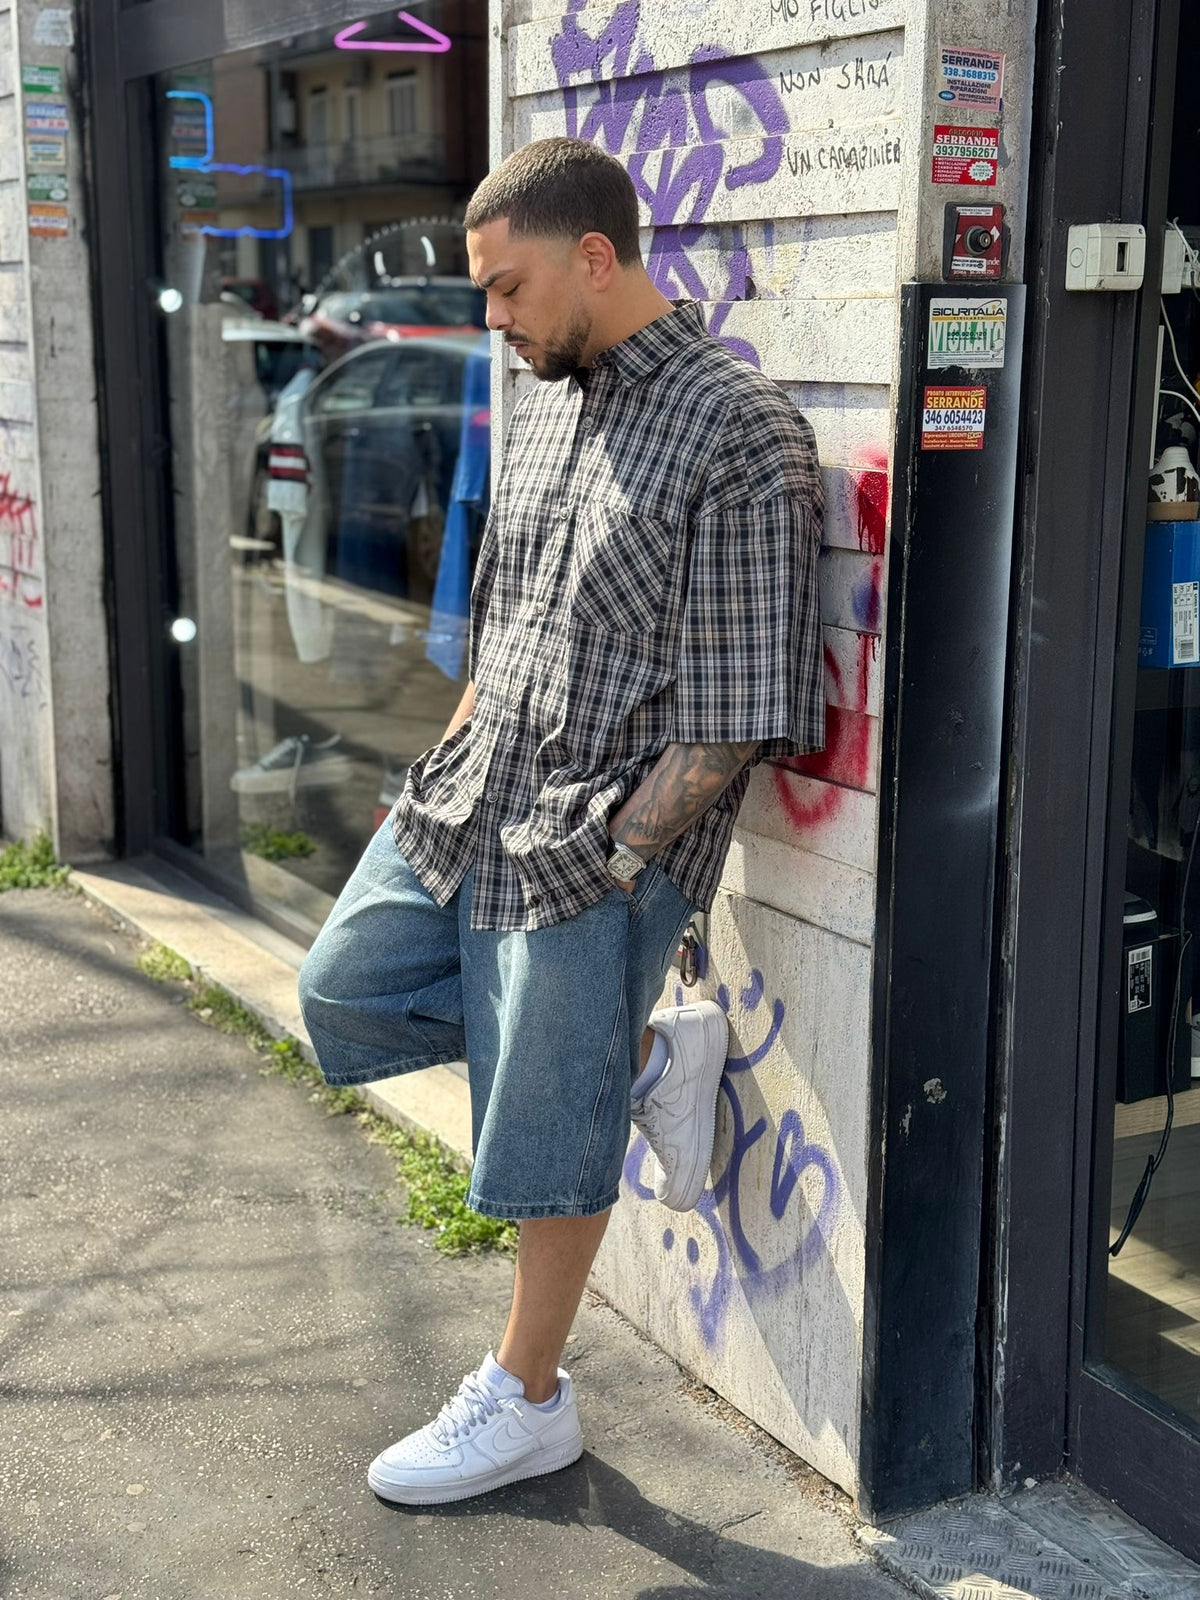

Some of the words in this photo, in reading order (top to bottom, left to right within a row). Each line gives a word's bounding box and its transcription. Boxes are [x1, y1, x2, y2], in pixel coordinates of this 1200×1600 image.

[941, 55, 1000, 70] SERRANDE
[780, 67, 821, 94] NON
[943, 66, 996, 81] 338.3688315
[947, 79, 991, 89] INSTALLAZIONI
[949, 85, 988, 94] RIPARAZIONI
[936, 134, 996, 146] SERRANDE
[935, 145, 996, 158] 3937956267
[787, 147, 811, 176] UN
[931, 321, 1005, 351] VIGILATO
[926, 397, 984, 408] SERRANDE
[924, 410, 942, 424] 346
[944, 410, 983, 424] 6054423
